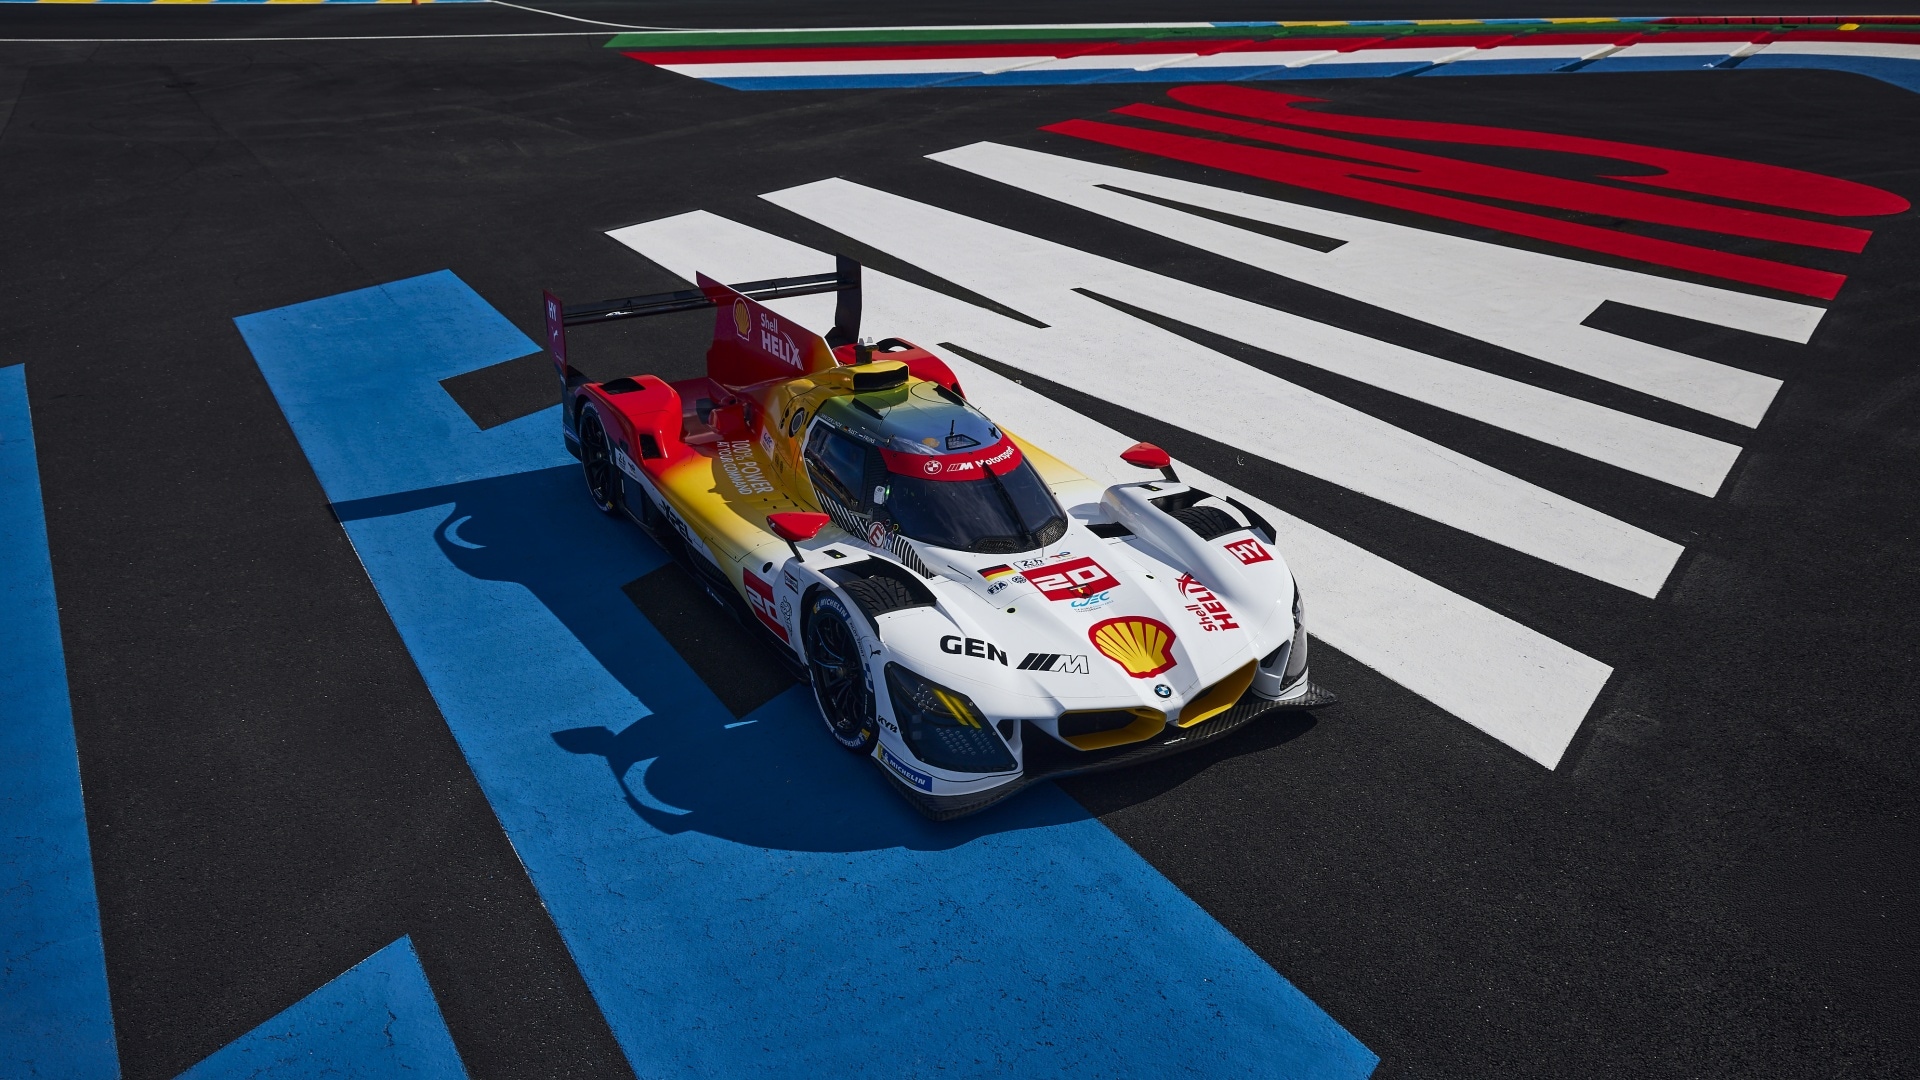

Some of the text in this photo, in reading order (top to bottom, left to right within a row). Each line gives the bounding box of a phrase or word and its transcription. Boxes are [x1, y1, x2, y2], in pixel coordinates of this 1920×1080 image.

[760, 312, 778, 335] Shell
[760, 329, 804, 371] HELIX
[718, 448, 735, 463] YOUR
[731, 440, 775, 494] 100% POWER
[723, 463, 753, 495] COMMAND
[1228, 541, 1265, 561] HY
[988, 581, 1007, 595] FIA
[1030, 564, 1109, 593] 20
[820, 597, 849, 619] MICHELIN
[1174, 570, 1241, 632] HELIX
[1184, 603, 1219, 632] Shell
[939, 634, 1008, 667] GEN
[889, 759, 926, 786] MICHELIN
